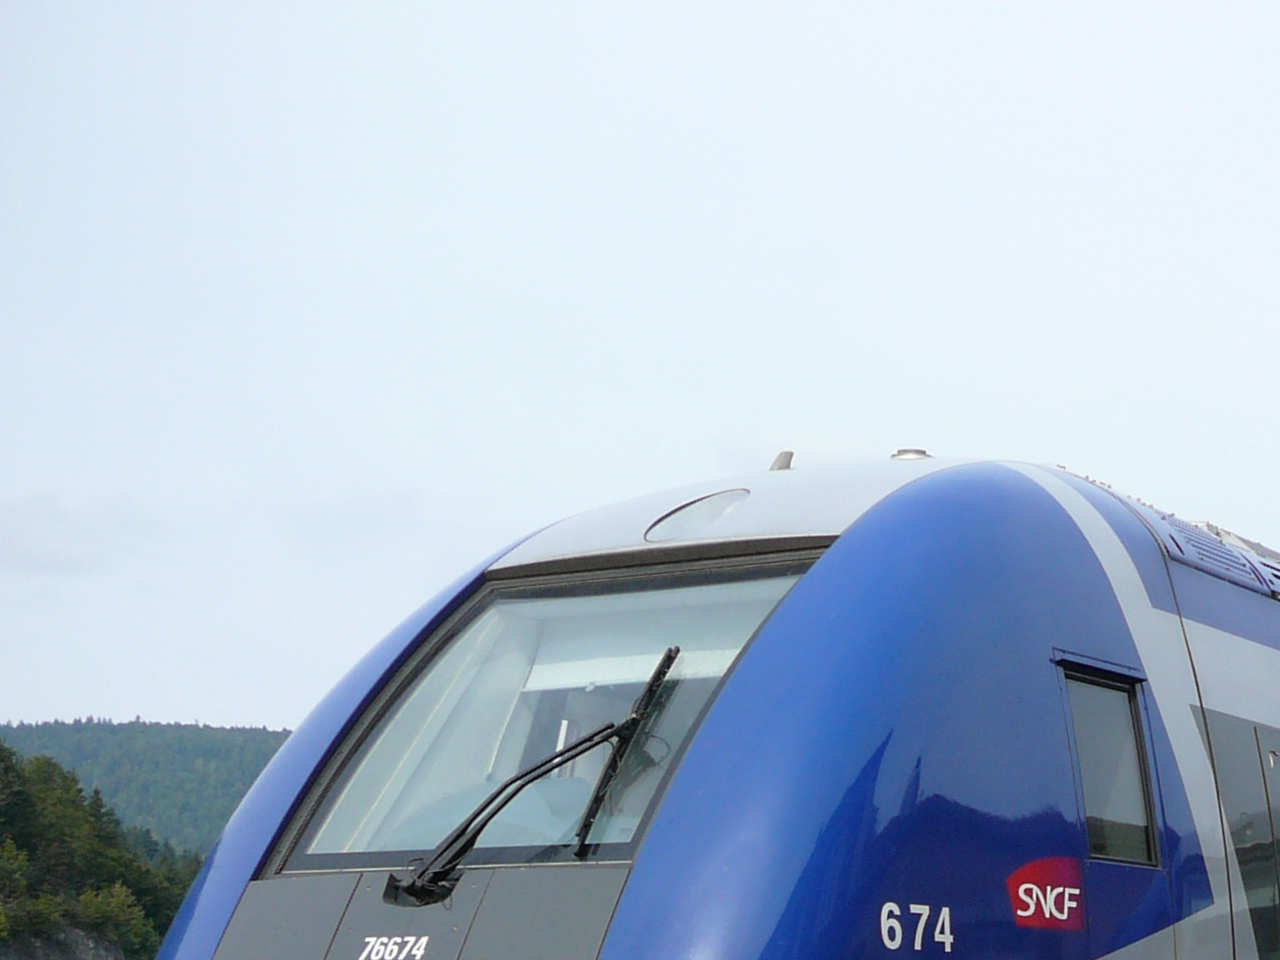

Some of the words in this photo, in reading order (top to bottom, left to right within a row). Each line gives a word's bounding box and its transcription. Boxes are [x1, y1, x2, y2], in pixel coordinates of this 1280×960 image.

[1016, 883, 1081, 920] SNCF
[880, 902, 954, 952] 674
[358, 935, 429, 960] 76674
